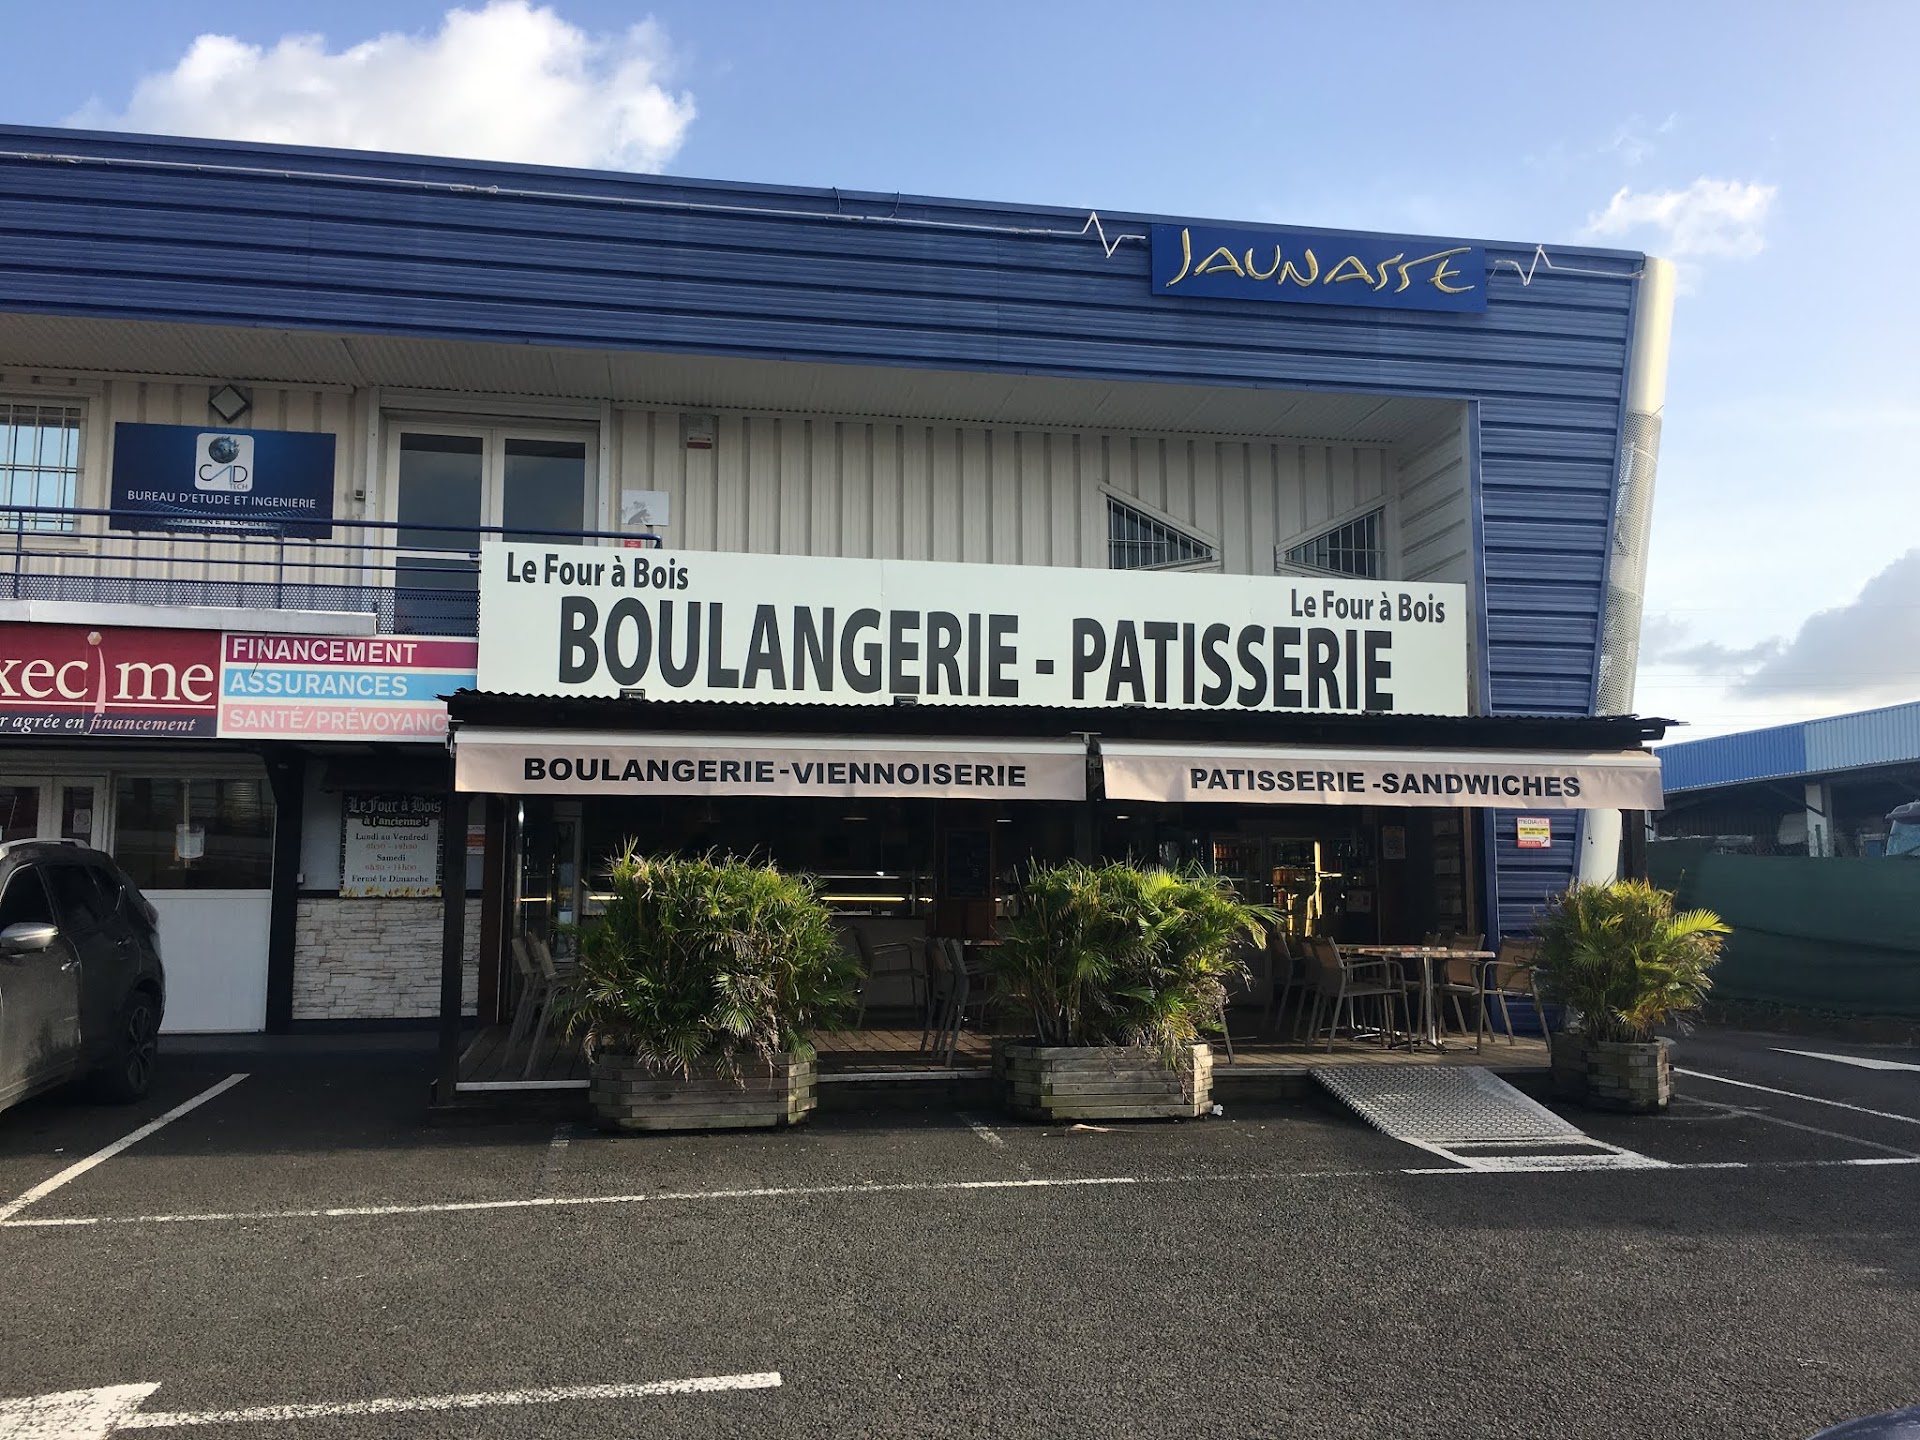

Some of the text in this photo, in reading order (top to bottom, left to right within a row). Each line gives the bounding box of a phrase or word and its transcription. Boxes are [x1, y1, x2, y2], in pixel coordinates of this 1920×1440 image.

[1166, 227, 1476, 294] JAUNASSE
[127, 489, 316, 509] BUREAU D'ETUDE ET INGENIERIE
[506, 551, 689, 590] Le Four à Bois
[1291, 588, 1445, 624] Le Four à Bois
[232, 636, 418, 665] FINANCEMENT
[559, 595, 1393, 711] BOULANGERIE - PATISSERIE
[229, 668, 408, 697] ASSURANCES
[12, 713, 61, 733] agrée
[63, 716, 84, 729] en
[88, 713, 195, 734] financement
[229, 706, 447, 733] SANTÉ/PRÉVOYANC
